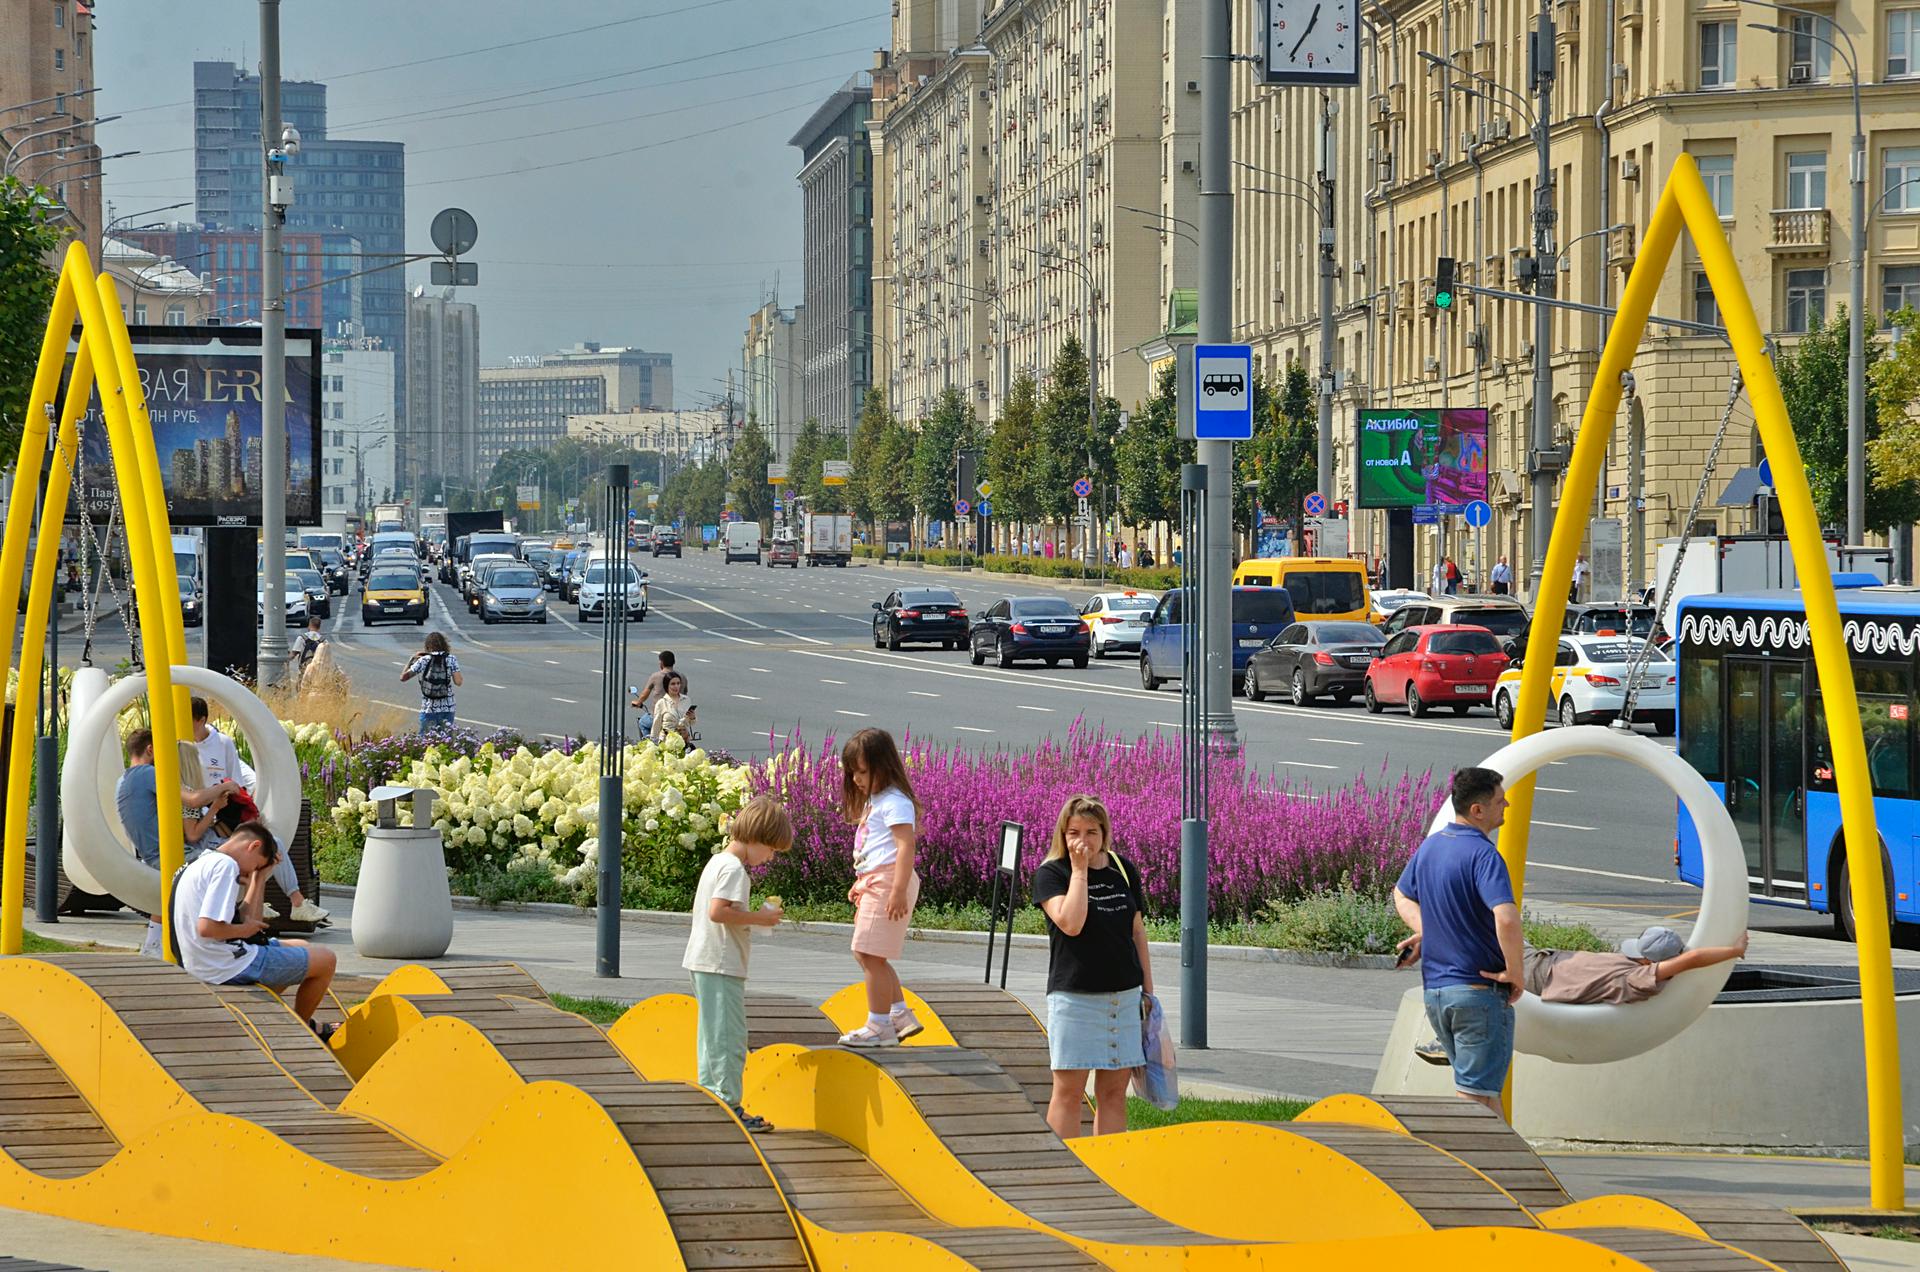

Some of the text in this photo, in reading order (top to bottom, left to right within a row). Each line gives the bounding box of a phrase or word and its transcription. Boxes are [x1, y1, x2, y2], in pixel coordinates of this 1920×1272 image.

[1279, 20, 1285, 30] 9
[1336, 22, 1343, 32] 3
[1307, 52, 1313, 62] 6
[173, 409, 200, 424] РУБ.
